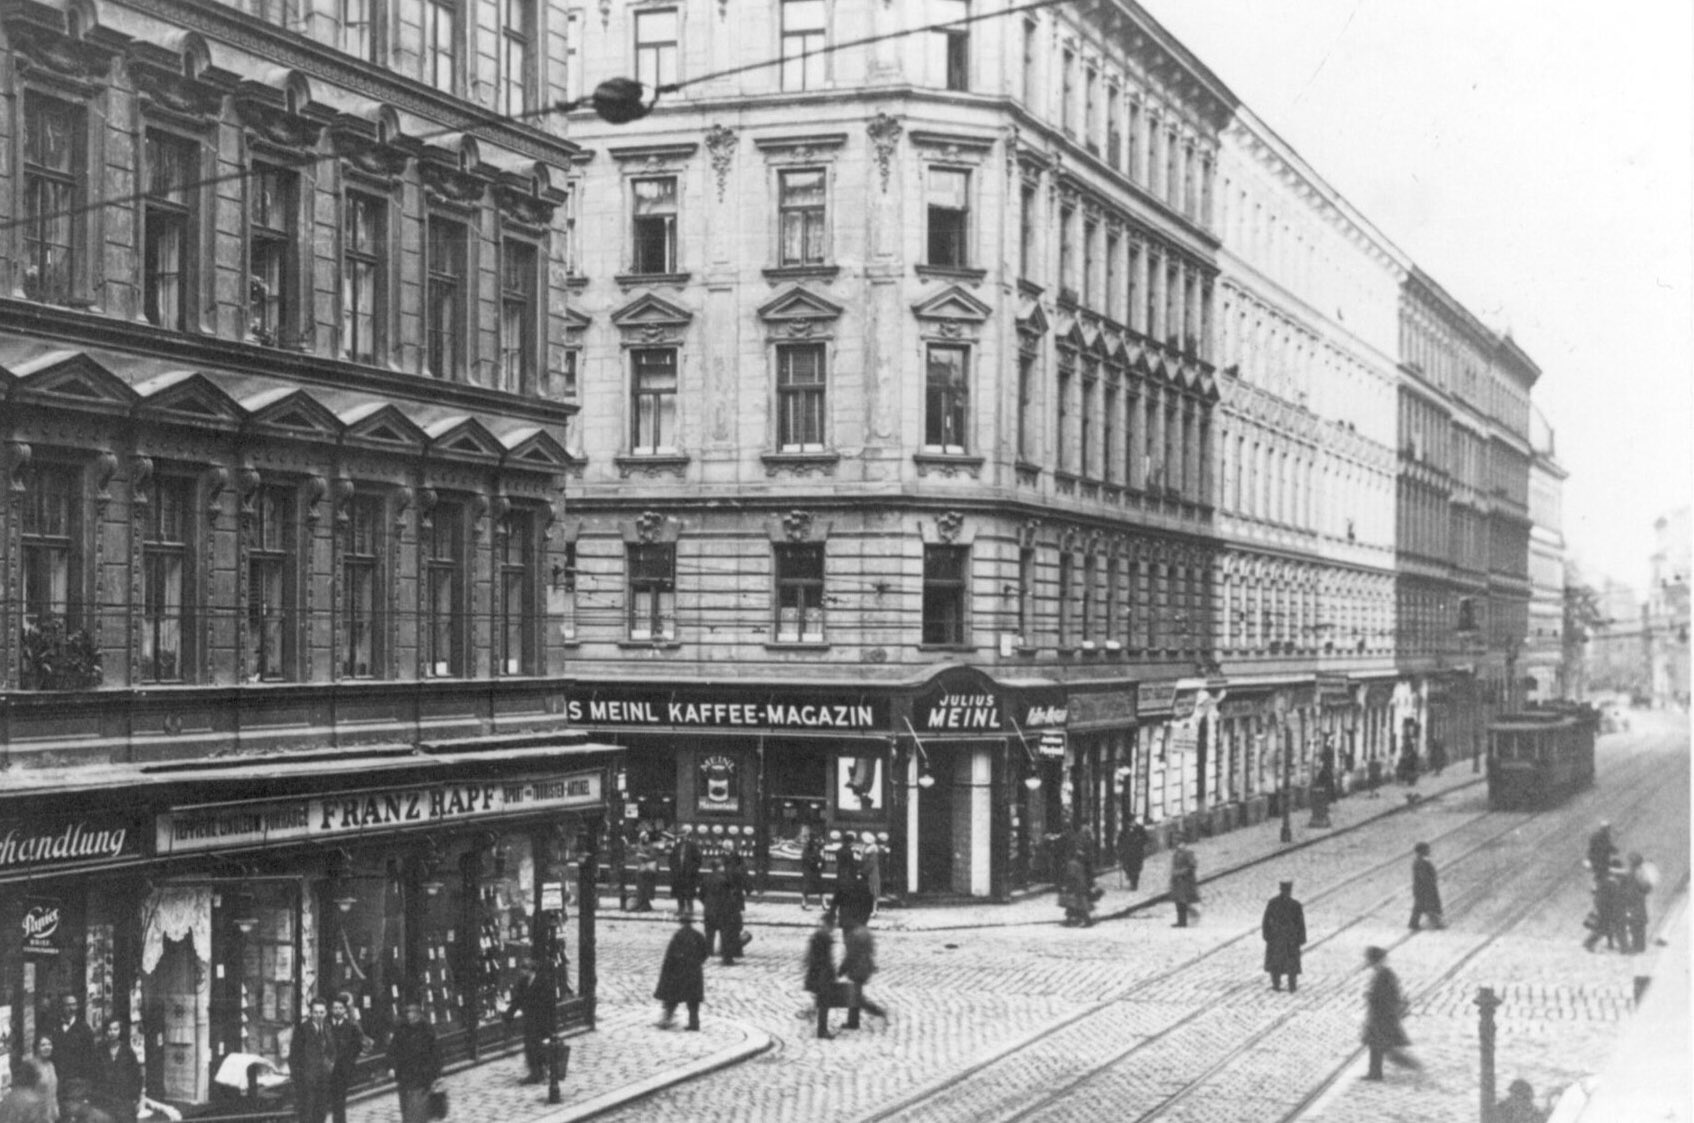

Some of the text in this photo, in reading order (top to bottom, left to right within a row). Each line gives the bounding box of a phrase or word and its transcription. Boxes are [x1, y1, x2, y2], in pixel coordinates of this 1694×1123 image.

[939, 694, 995, 707] JULIUS
[589, 701, 659, 722] MEINL
[668, 703, 873, 727] KAFFEE-MAGAZIN
[927, 707, 1001, 728] MEINL
[700, 755, 735, 774] MEINL
[320, 791, 422, 830] FRANZ
[0, 821, 126, 865] handlung
